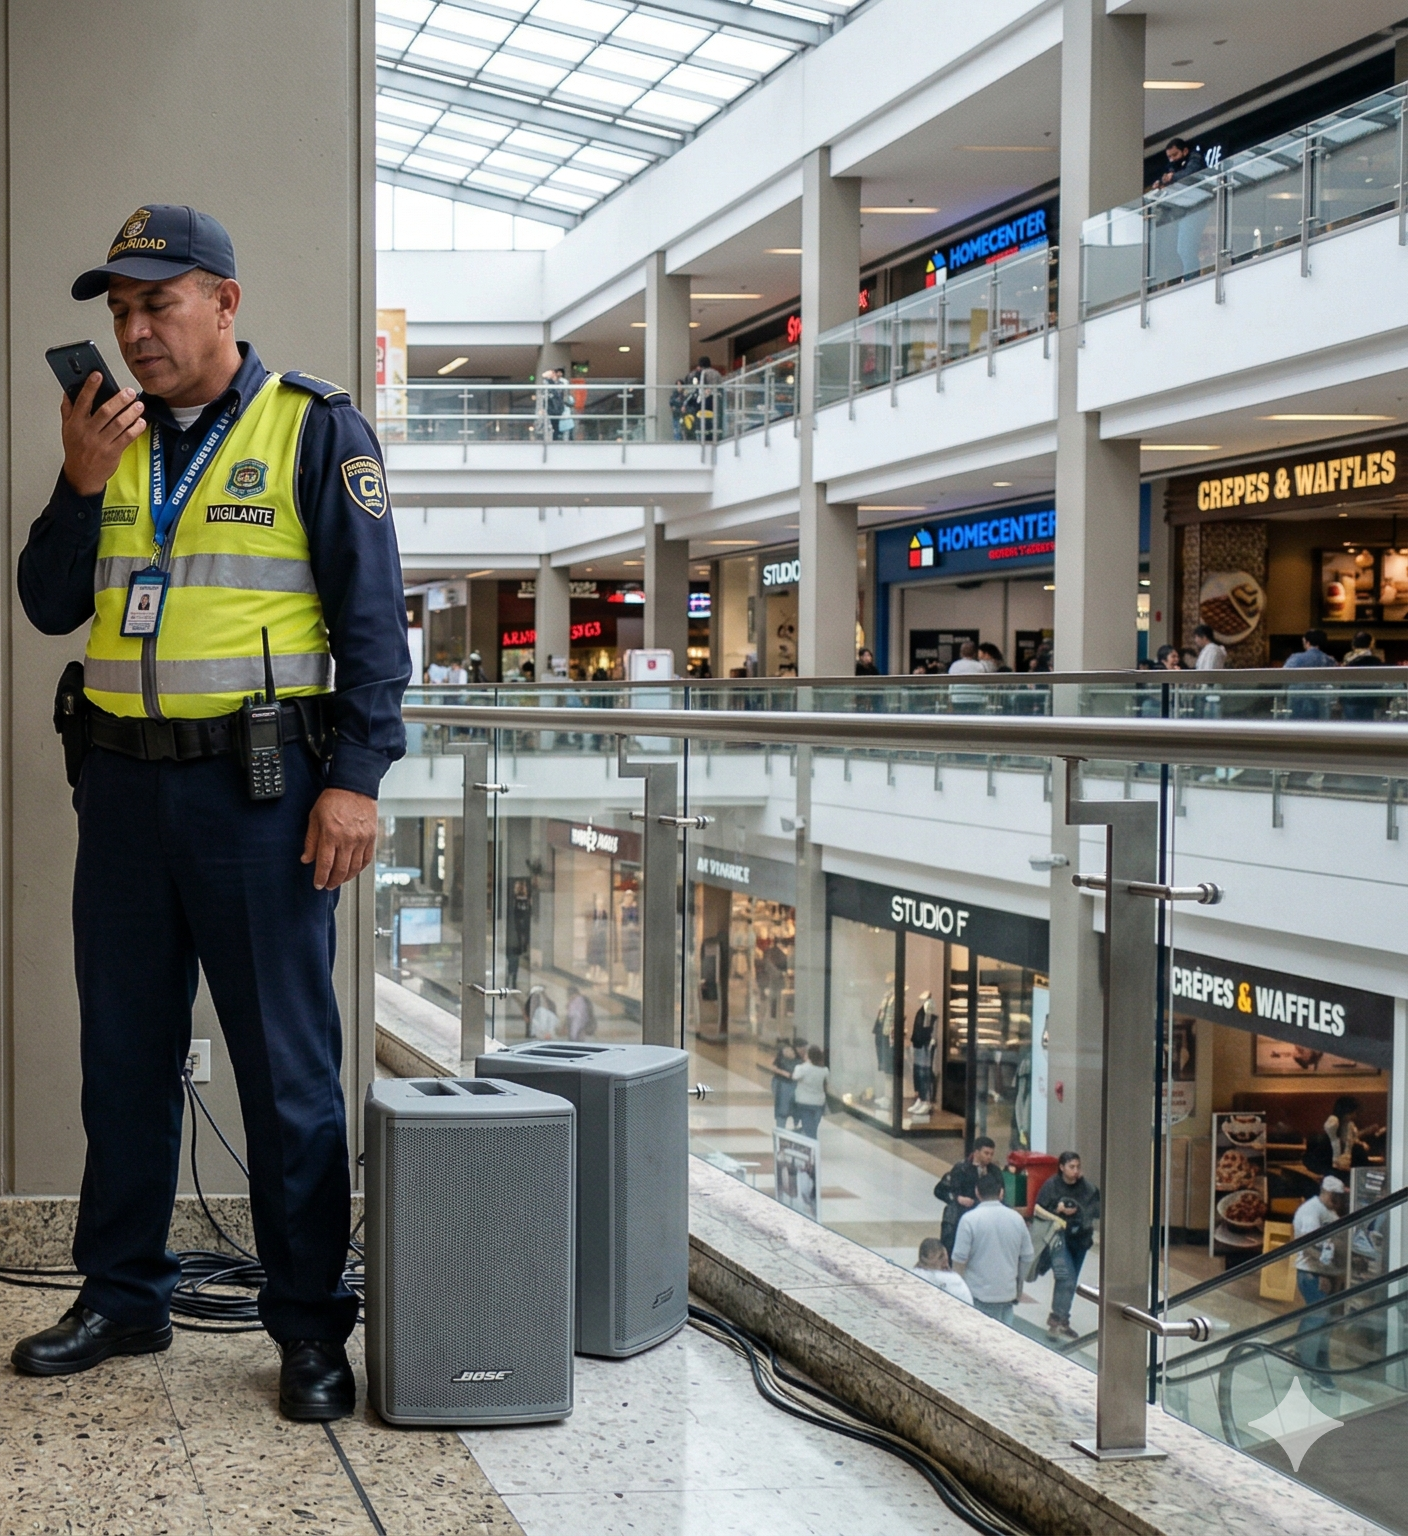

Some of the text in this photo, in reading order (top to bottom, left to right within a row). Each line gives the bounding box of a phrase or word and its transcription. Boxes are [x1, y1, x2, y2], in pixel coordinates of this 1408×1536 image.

[949, 209, 1047, 270] HOMECENTER
[1197, 450, 1396, 511] CREPES & WAFFLES
[209, 506, 273, 525] VIGILANTE
[762, 560, 801, 586] STUDIO
[891, 895, 970, 937] STUDIO F
[1237, 982, 1252, 1013] &
[1255, 985, 1345, 1036] WAFFLES
[452, 1370, 513, 1381] BOSE
